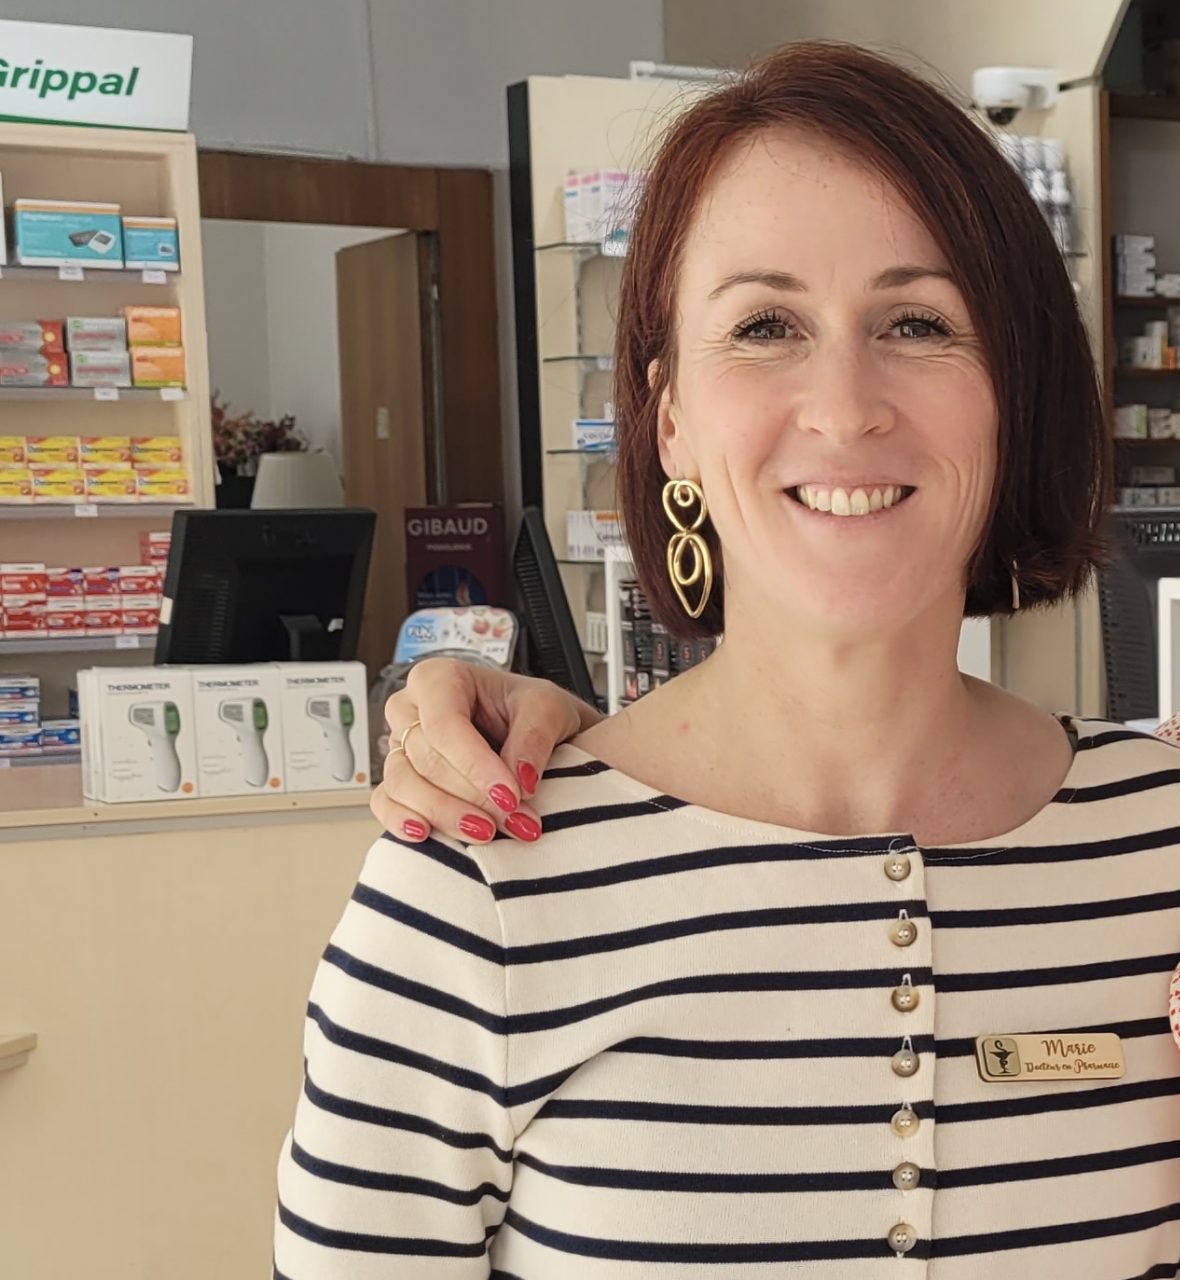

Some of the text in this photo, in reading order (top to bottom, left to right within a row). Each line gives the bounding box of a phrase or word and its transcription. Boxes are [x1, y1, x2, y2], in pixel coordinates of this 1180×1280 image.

[408, 517, 488, 536] GIBAUD
[108, 682, 171, 692] THERMOMETER
[198, 679, 259, 689] THERMOMETER
[286, 676, 345, 686] THERMOMETER
[1041, 1038, 1096, 1058] Marie
[1024, 1061, 1061, 1073] Docteur
[1073, 1058, 1121, 1074] Pharmacie
